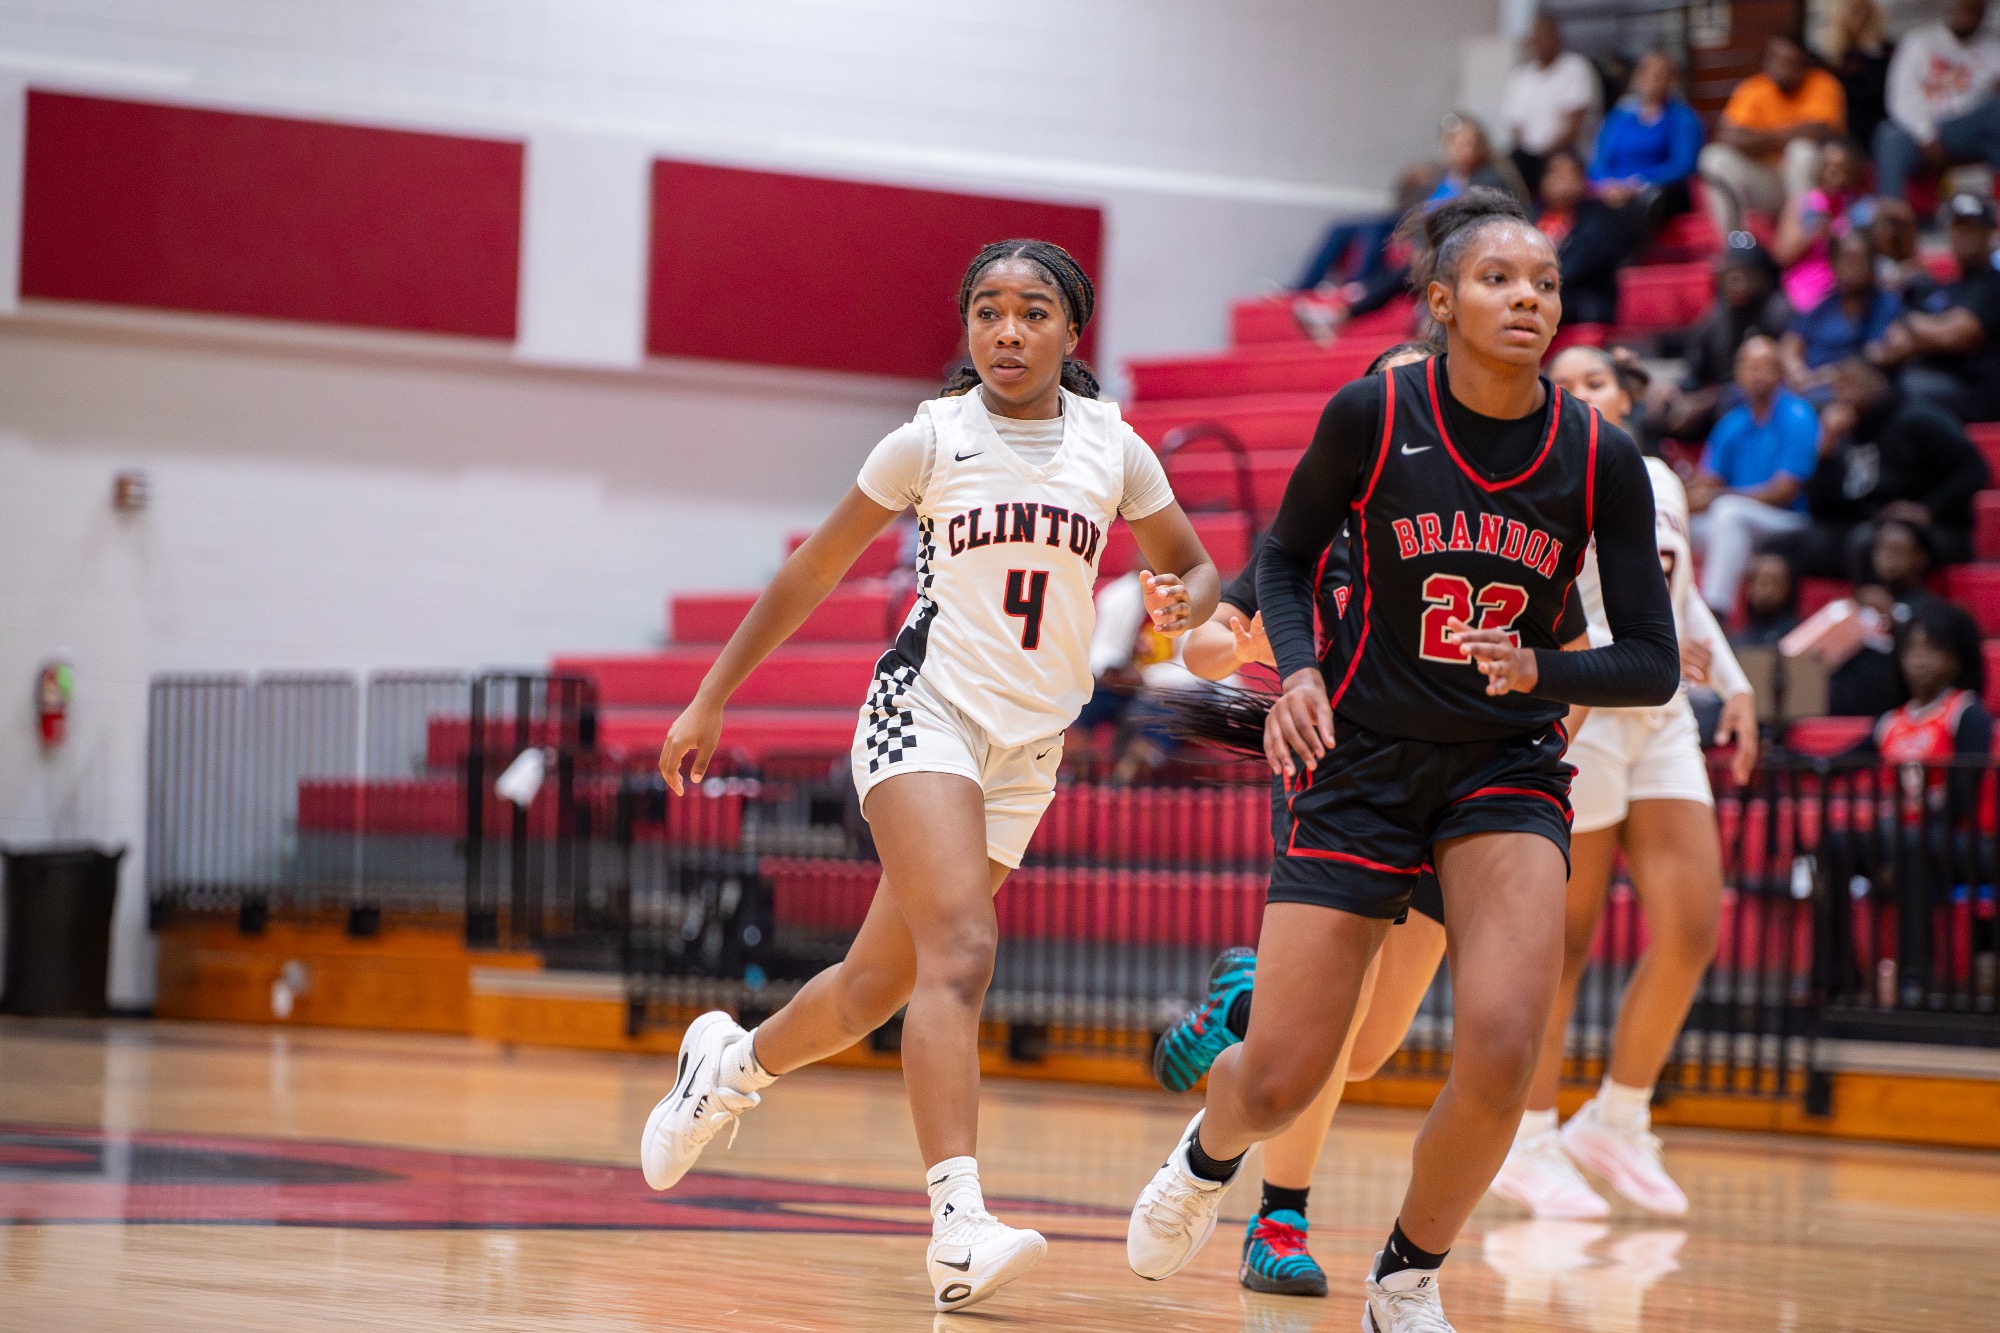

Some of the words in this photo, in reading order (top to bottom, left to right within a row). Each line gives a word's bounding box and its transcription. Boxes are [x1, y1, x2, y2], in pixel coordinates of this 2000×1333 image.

[948, 502, 1101, 568] CLINTON
[1392, 510, 1563, 580] BRANDON
[1003, 568, 1049, 650] 4
[1419, 572, 1529, 664] 22
